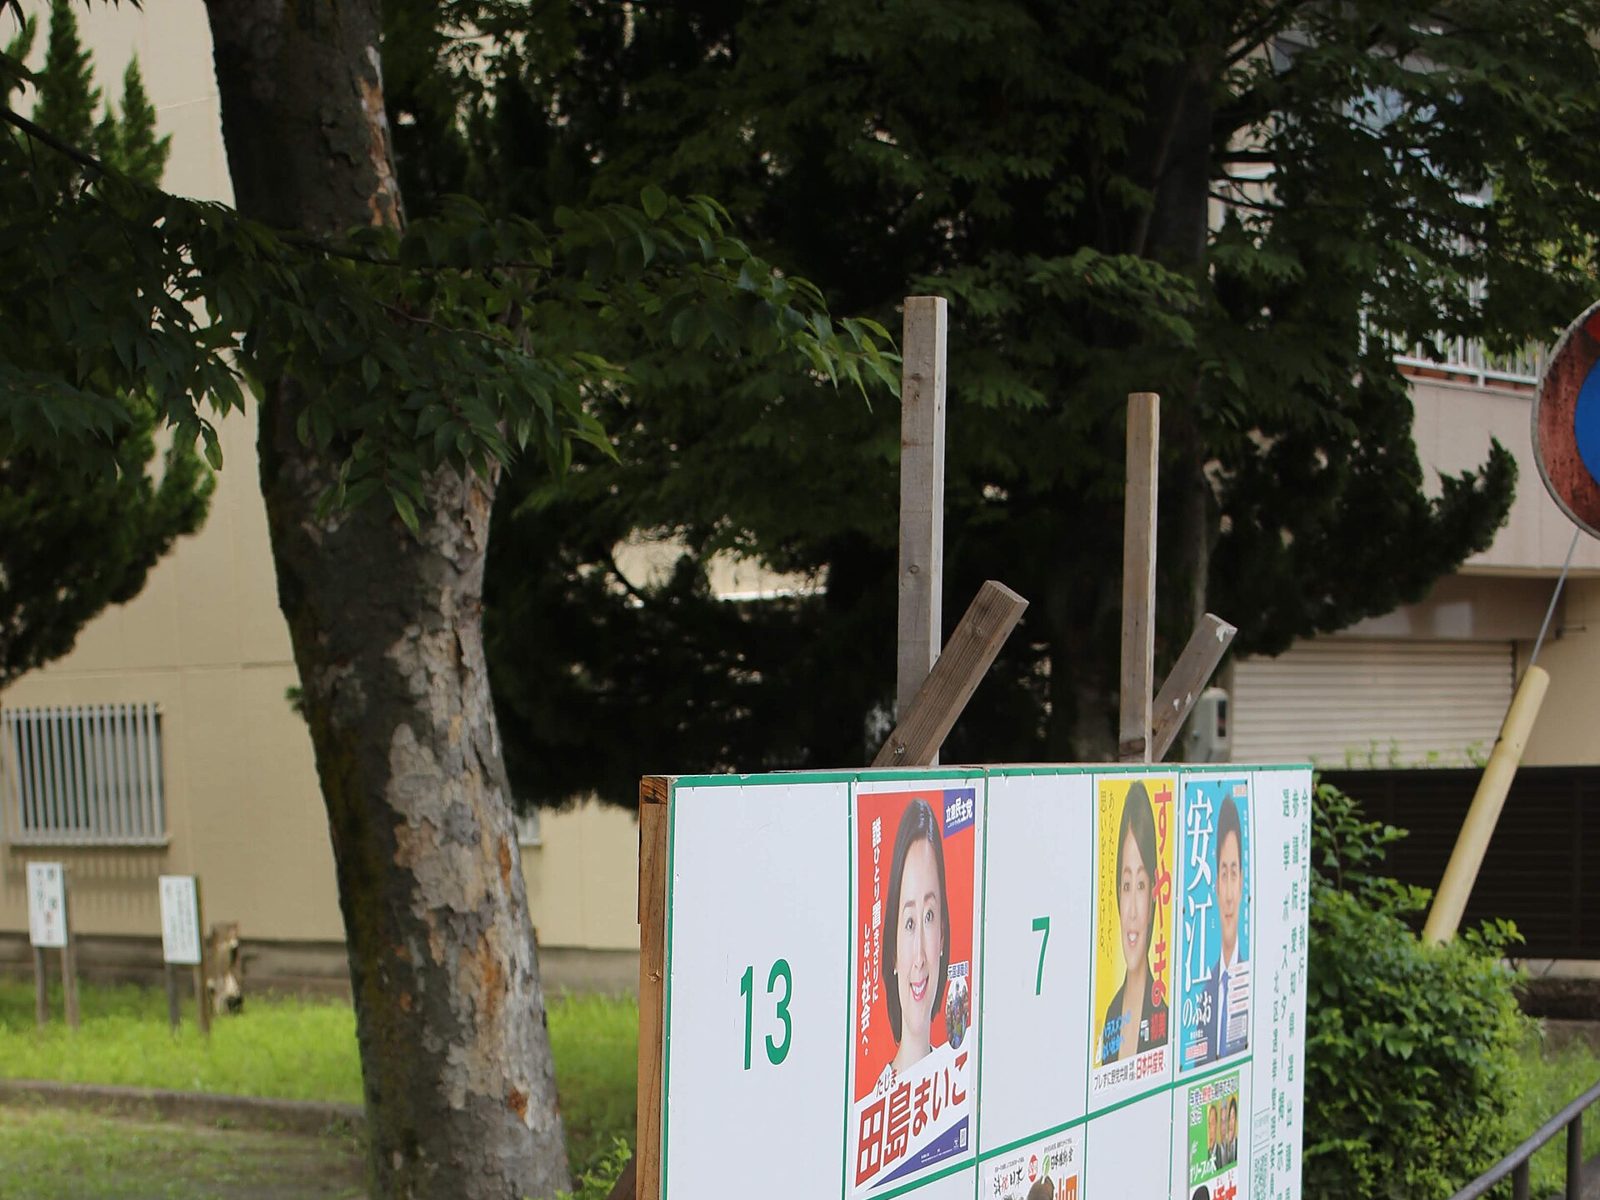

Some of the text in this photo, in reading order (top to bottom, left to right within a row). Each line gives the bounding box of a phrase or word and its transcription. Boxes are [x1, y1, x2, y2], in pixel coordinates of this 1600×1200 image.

[871, 817, 882, 1004] 誰ひとり置きざりに
[1032, 916, 1051, 995] 7
[1151, 784, 1174, 1008] すやま
[1184, 790, 1214, 992] 安江
[740, 958, 793, 1071] 13
[861, 923, 872, 1056] しない社会へ。
[1183, 991, 1213, 1028] のぶお
[855, 1051, 968, 1187] 田島まいこ
[876, 1068, 898, 1098] たじま
